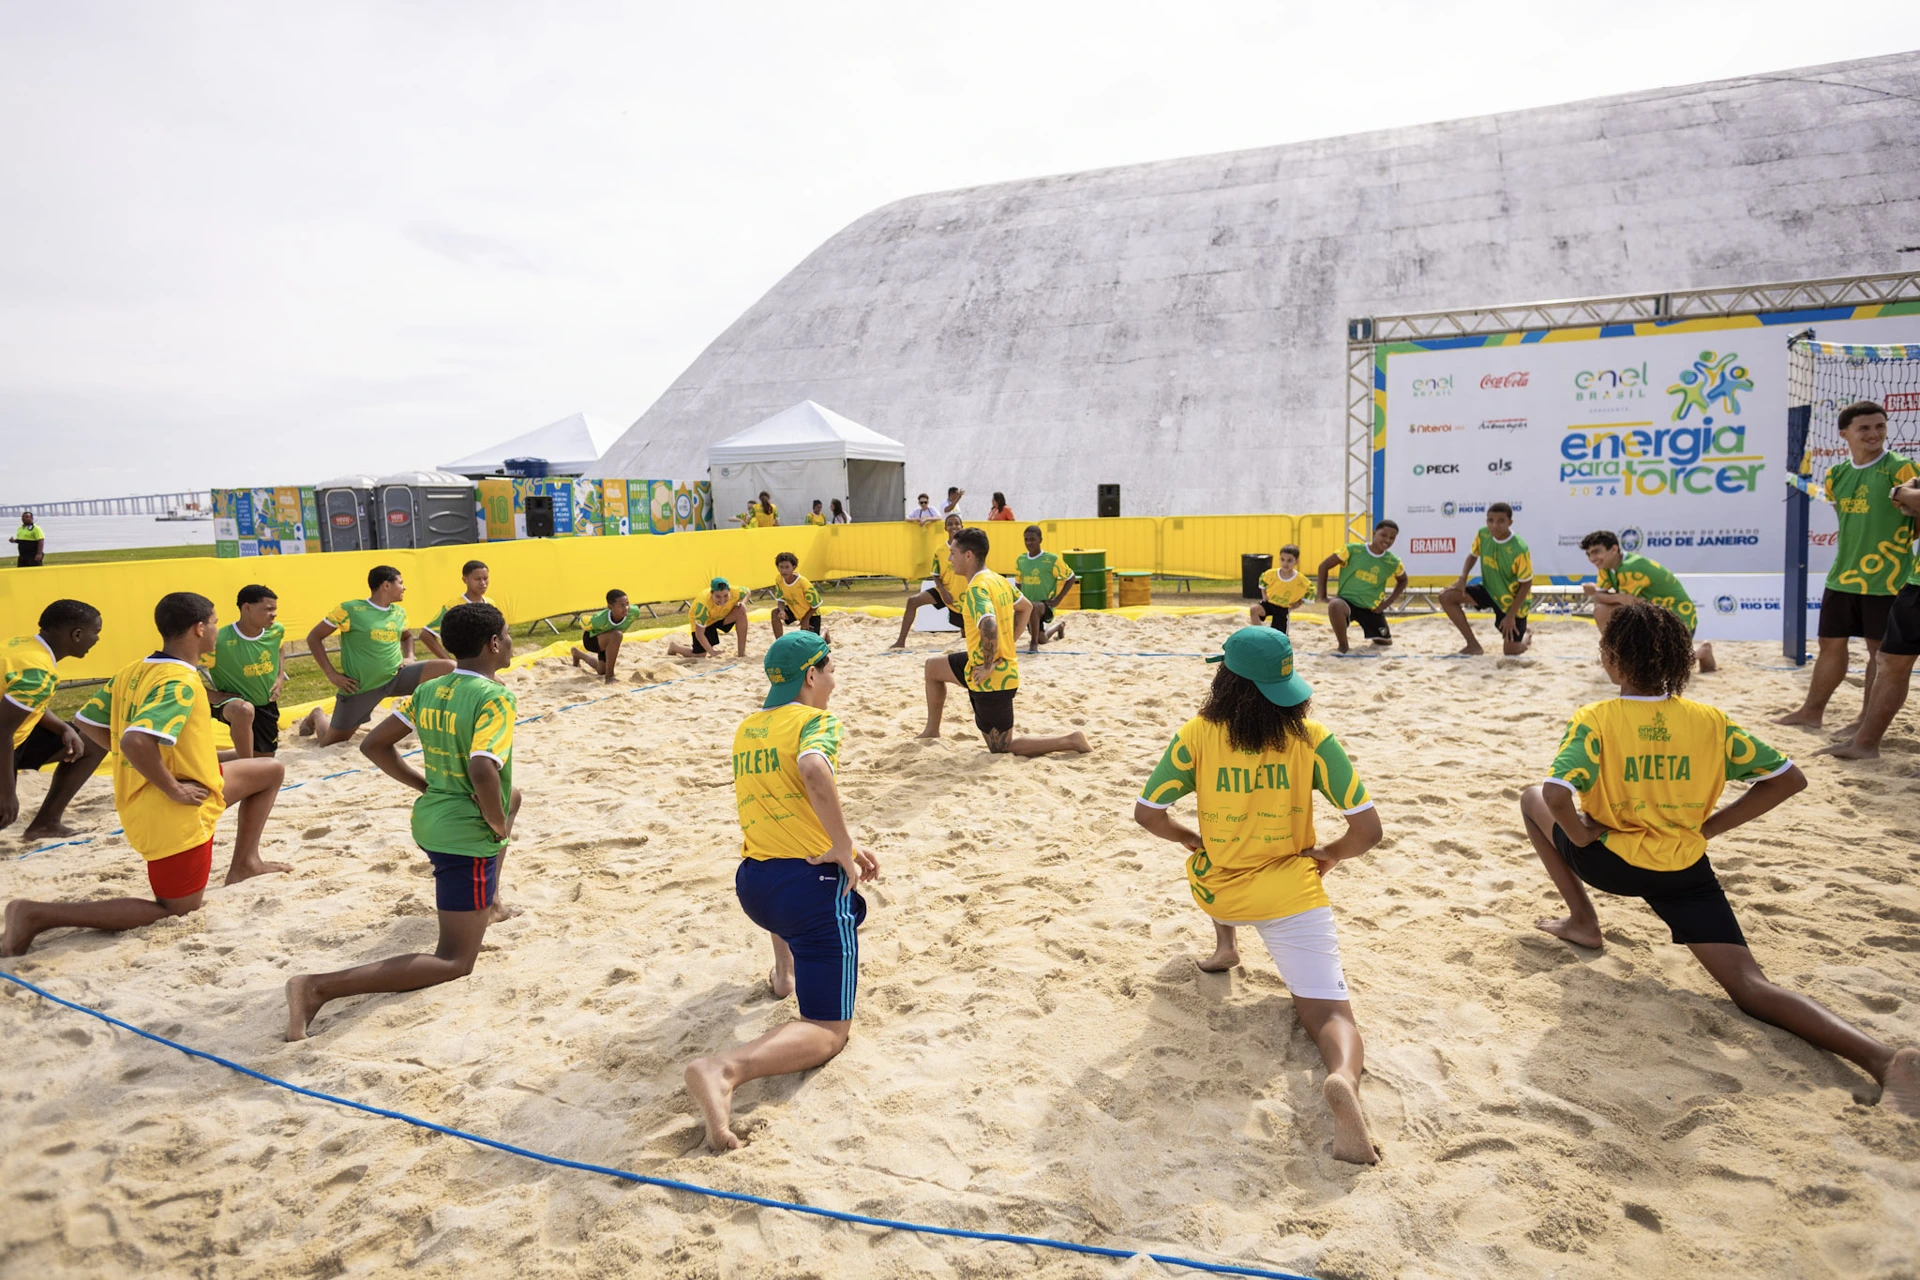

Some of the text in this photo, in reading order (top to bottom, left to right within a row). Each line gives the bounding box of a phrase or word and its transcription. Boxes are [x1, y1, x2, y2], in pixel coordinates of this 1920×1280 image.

[1412, 374, 1453, 391] enel
[1480, 371, 1529, 389] Coca-Cola
[1575, 361, 1648, 389] enel
[1576, 390, 1646, 401] BRASIL
[1560, 416, 1746, 466] energia
[1426, 464, 1460, 474] PECK
[1488, 458, 1512, 472] als
[1560, 461, 1620, 482] para
[1621, 460, 1765, 496] torcer
[630, 483, 648, 491] BRASIL
[1569, 486, 1617, 497] 2026
[487, 495, 509, 524] 10
[631, 522, 649, 530] BRASIL
[1412, 538, 1455, 552] BRAHMA
[1647, 535, 1759, 548] RIO DE JANEIRO
[1740, 602, 1781, 610] RIO DE
[419, 707, 457, 735] ATLTA
[1216, 764, 1290, 794] ATLETA
